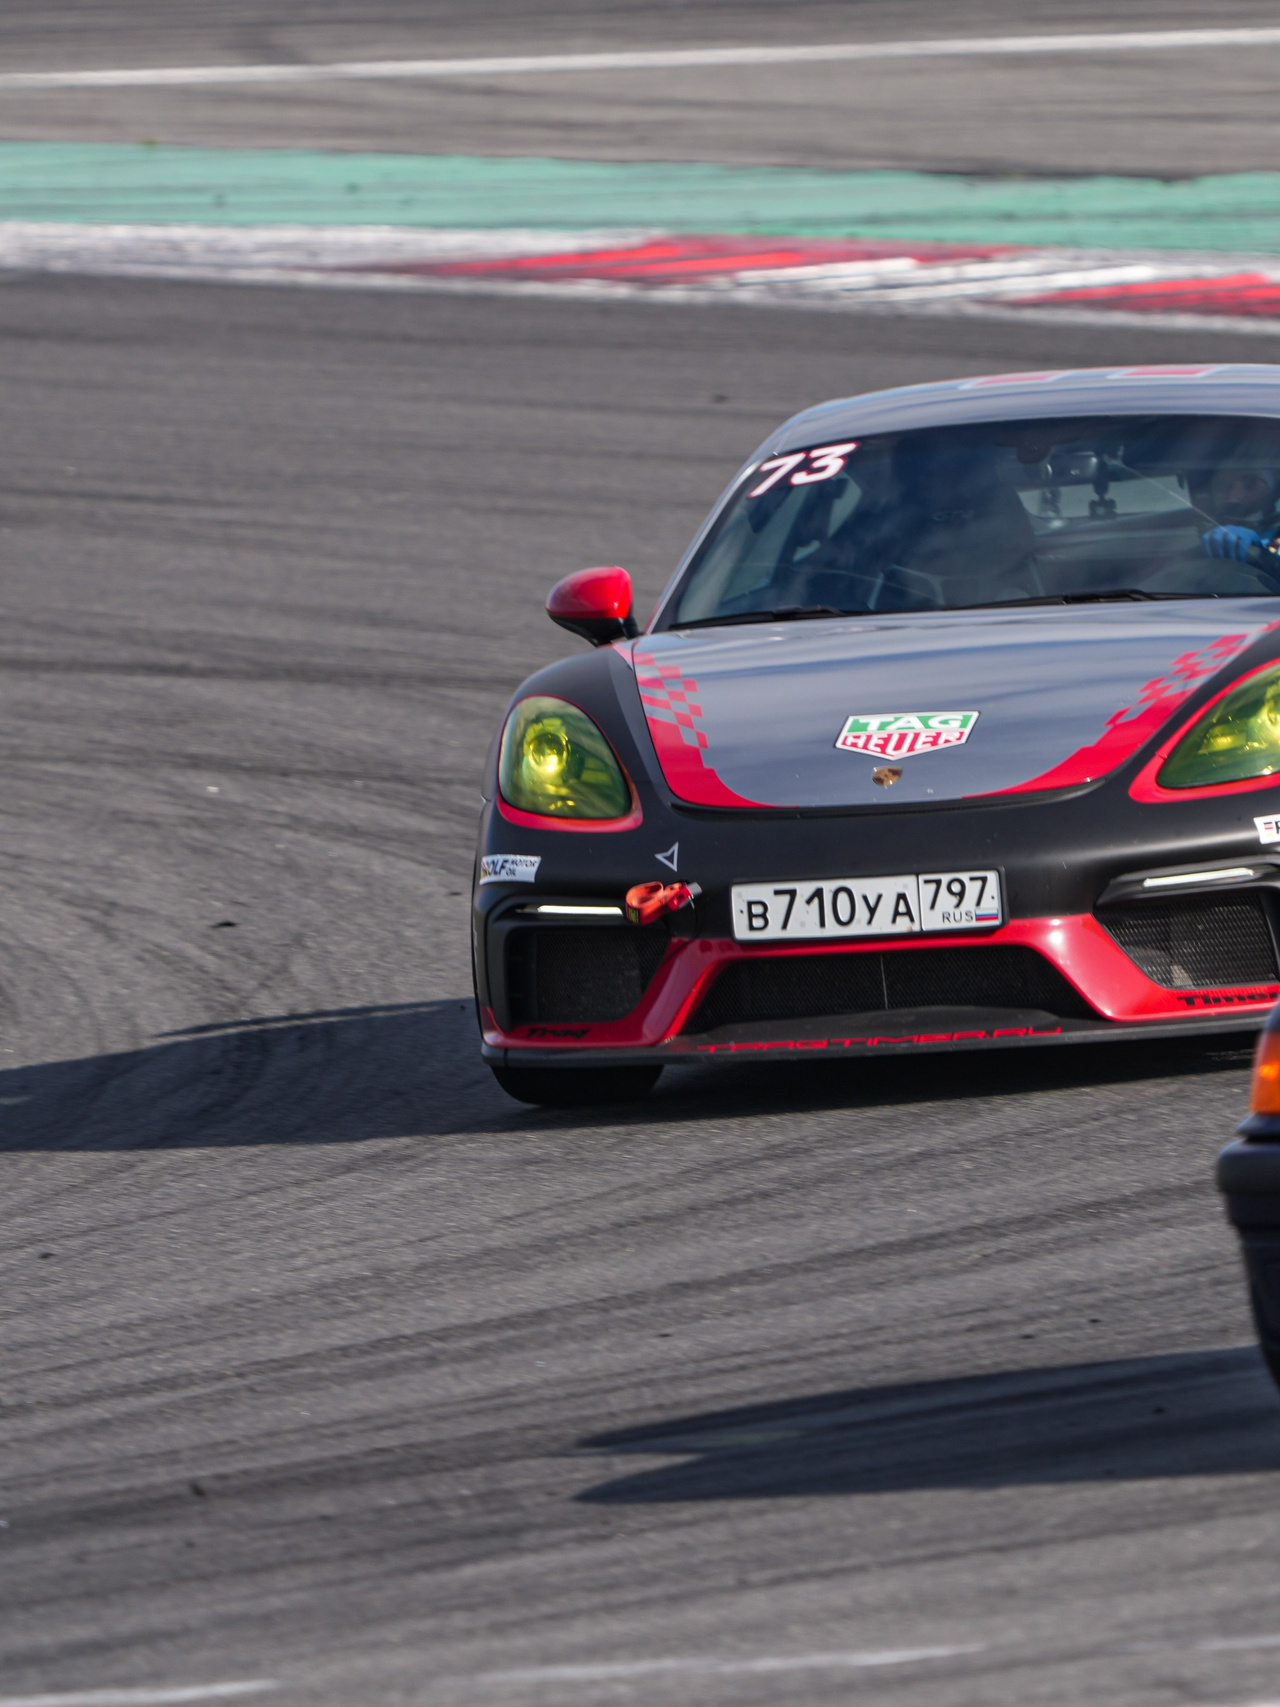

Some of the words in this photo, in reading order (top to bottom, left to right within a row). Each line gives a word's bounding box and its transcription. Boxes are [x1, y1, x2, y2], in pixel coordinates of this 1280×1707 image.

[748, 441, 859, 499] 73
[858, 714, 964, 731] TAG
[845, 731, 961, 756] HEUER
[923, 875, 988, 911] 797
[941, 910, 974, 924] RUS
